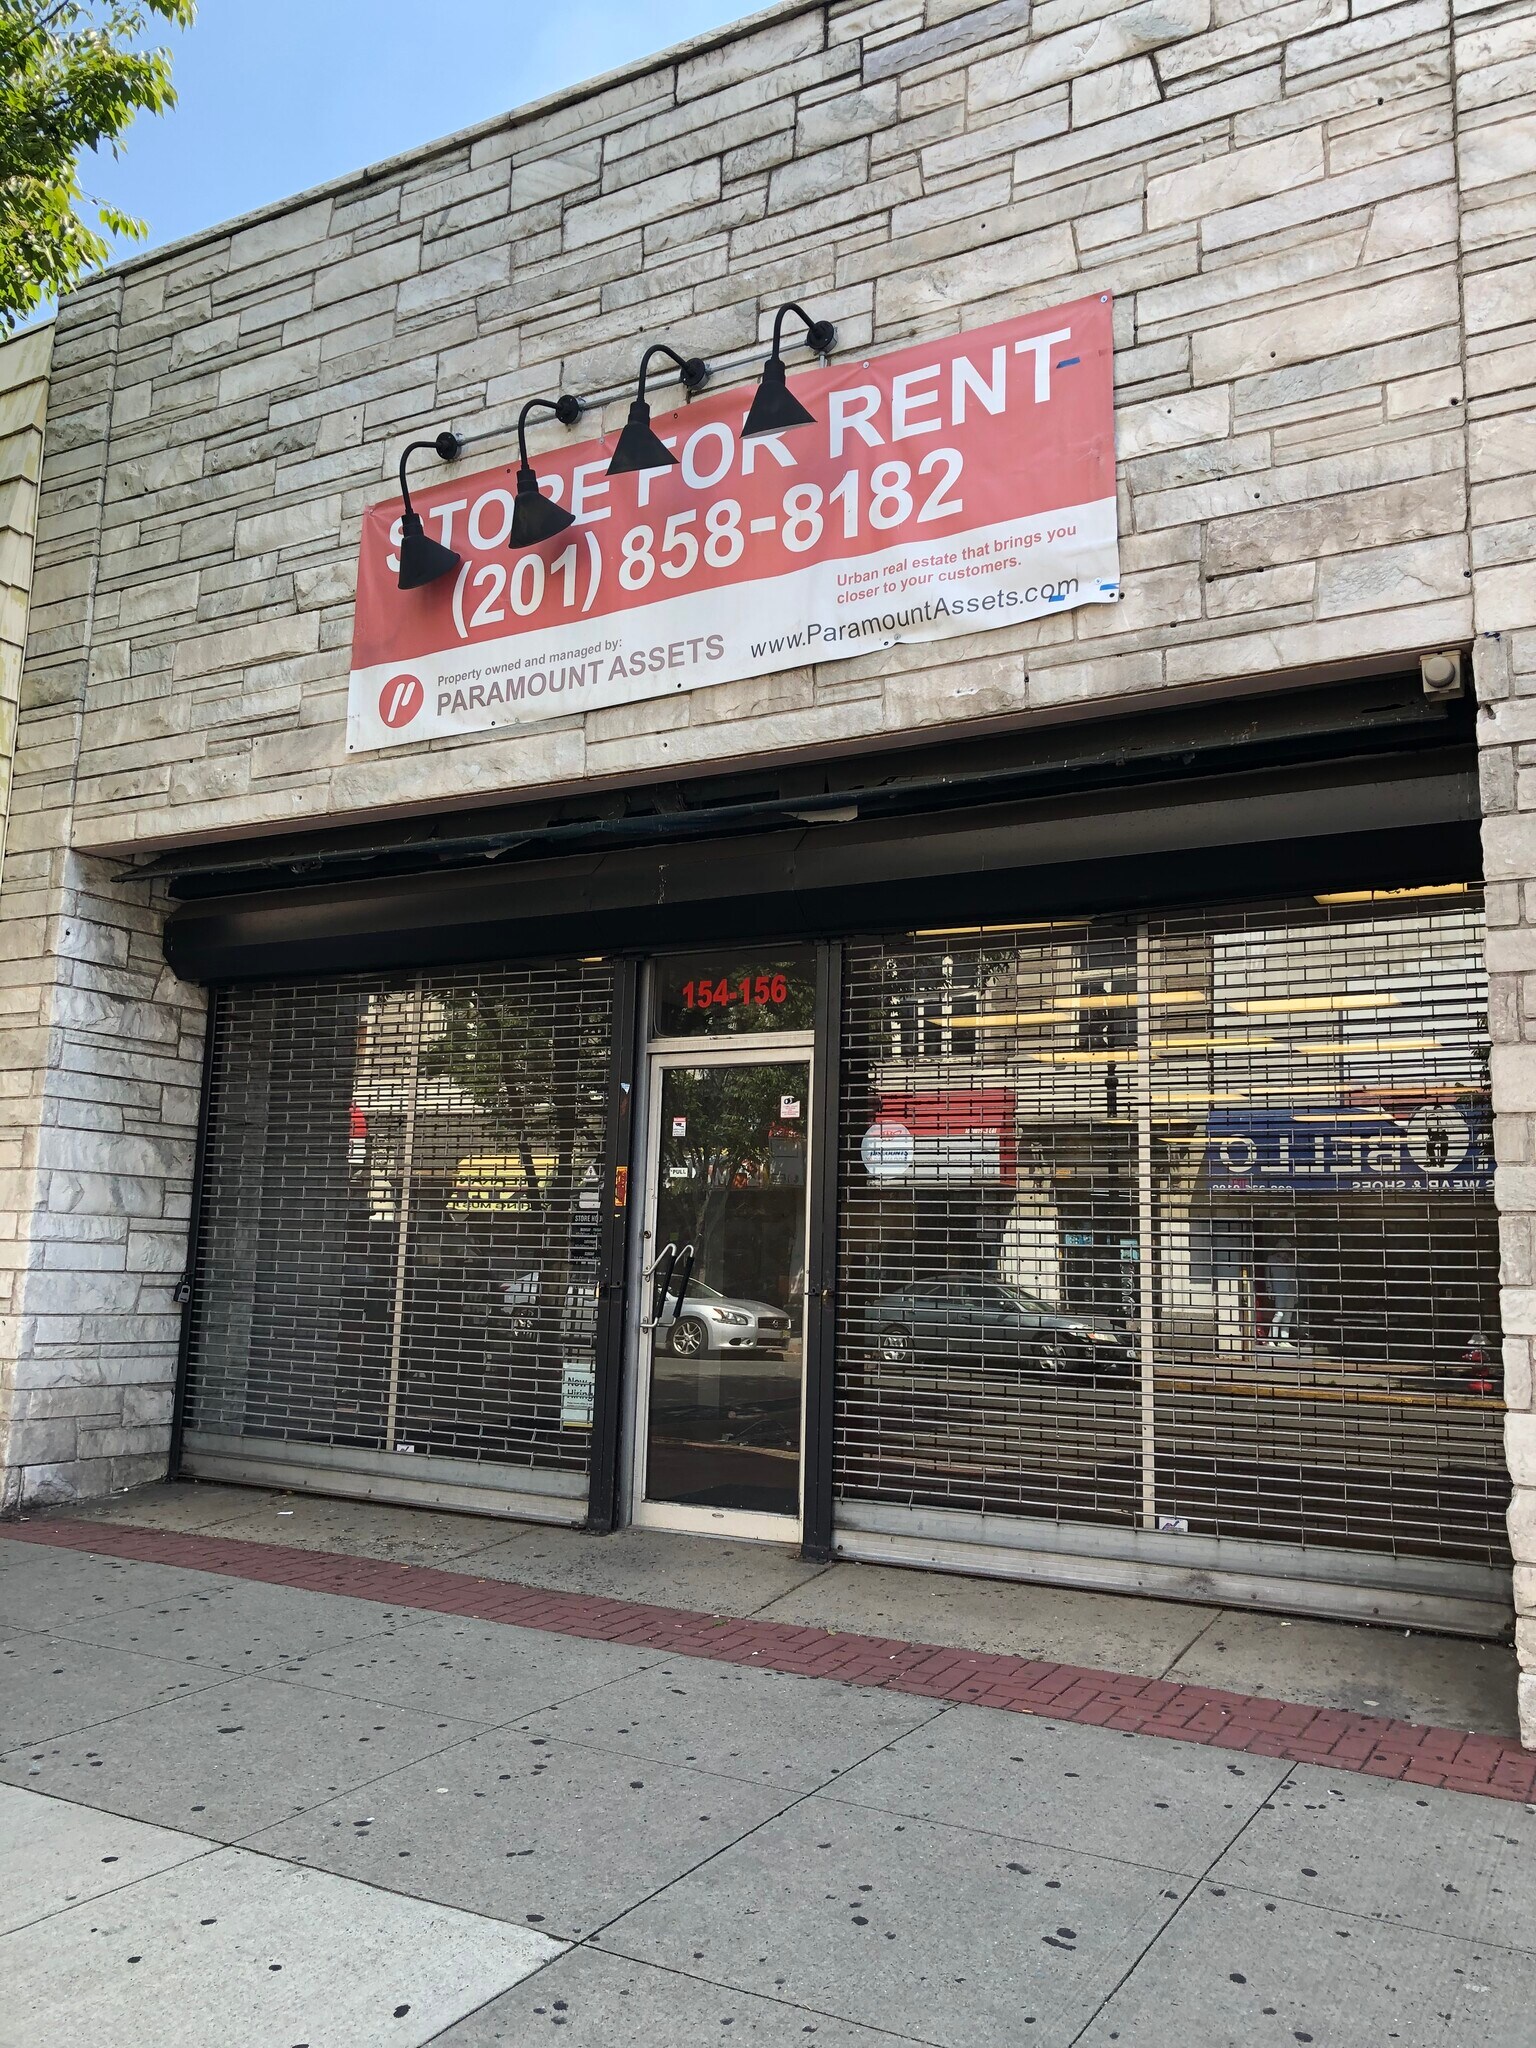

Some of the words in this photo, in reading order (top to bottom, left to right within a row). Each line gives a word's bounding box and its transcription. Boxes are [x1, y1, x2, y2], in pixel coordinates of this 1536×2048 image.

[828, 327, 1071, 459] RENT
[451, 530, 603, 639] (201)
[618, 447, 964, 592] 858-8182
[836, 570, 879, 587] Urban
[883, 559, 908, 579] real
[912, 553, 957, 568] estate
[961, 543, 990, 561] that
[993, 533, 1042, 553] brings
[1046, 525, 1077, 545] you
[836, 587, 879, 604] closer
[883, 580, 897, 593] to
[900, 572, 934, 593] your
[938, 556, 1022, 582] customers.
[750, 577, 1080, 658] www.ParamountAssets.com
[436, 660, 604, 716] PARAMOUNT
[608, 634, 725, 681] ASSETS
[437, 668, 482, 687] Property
[484, 659, 521, 676] owned
[524, 654, 546, 668] and
[549, 641, 602, 664] managed
[604, 637, 622, 653] by:
[682, 974, 787, 1009] 154-156
[567, 1376, 588, 1387] Now
